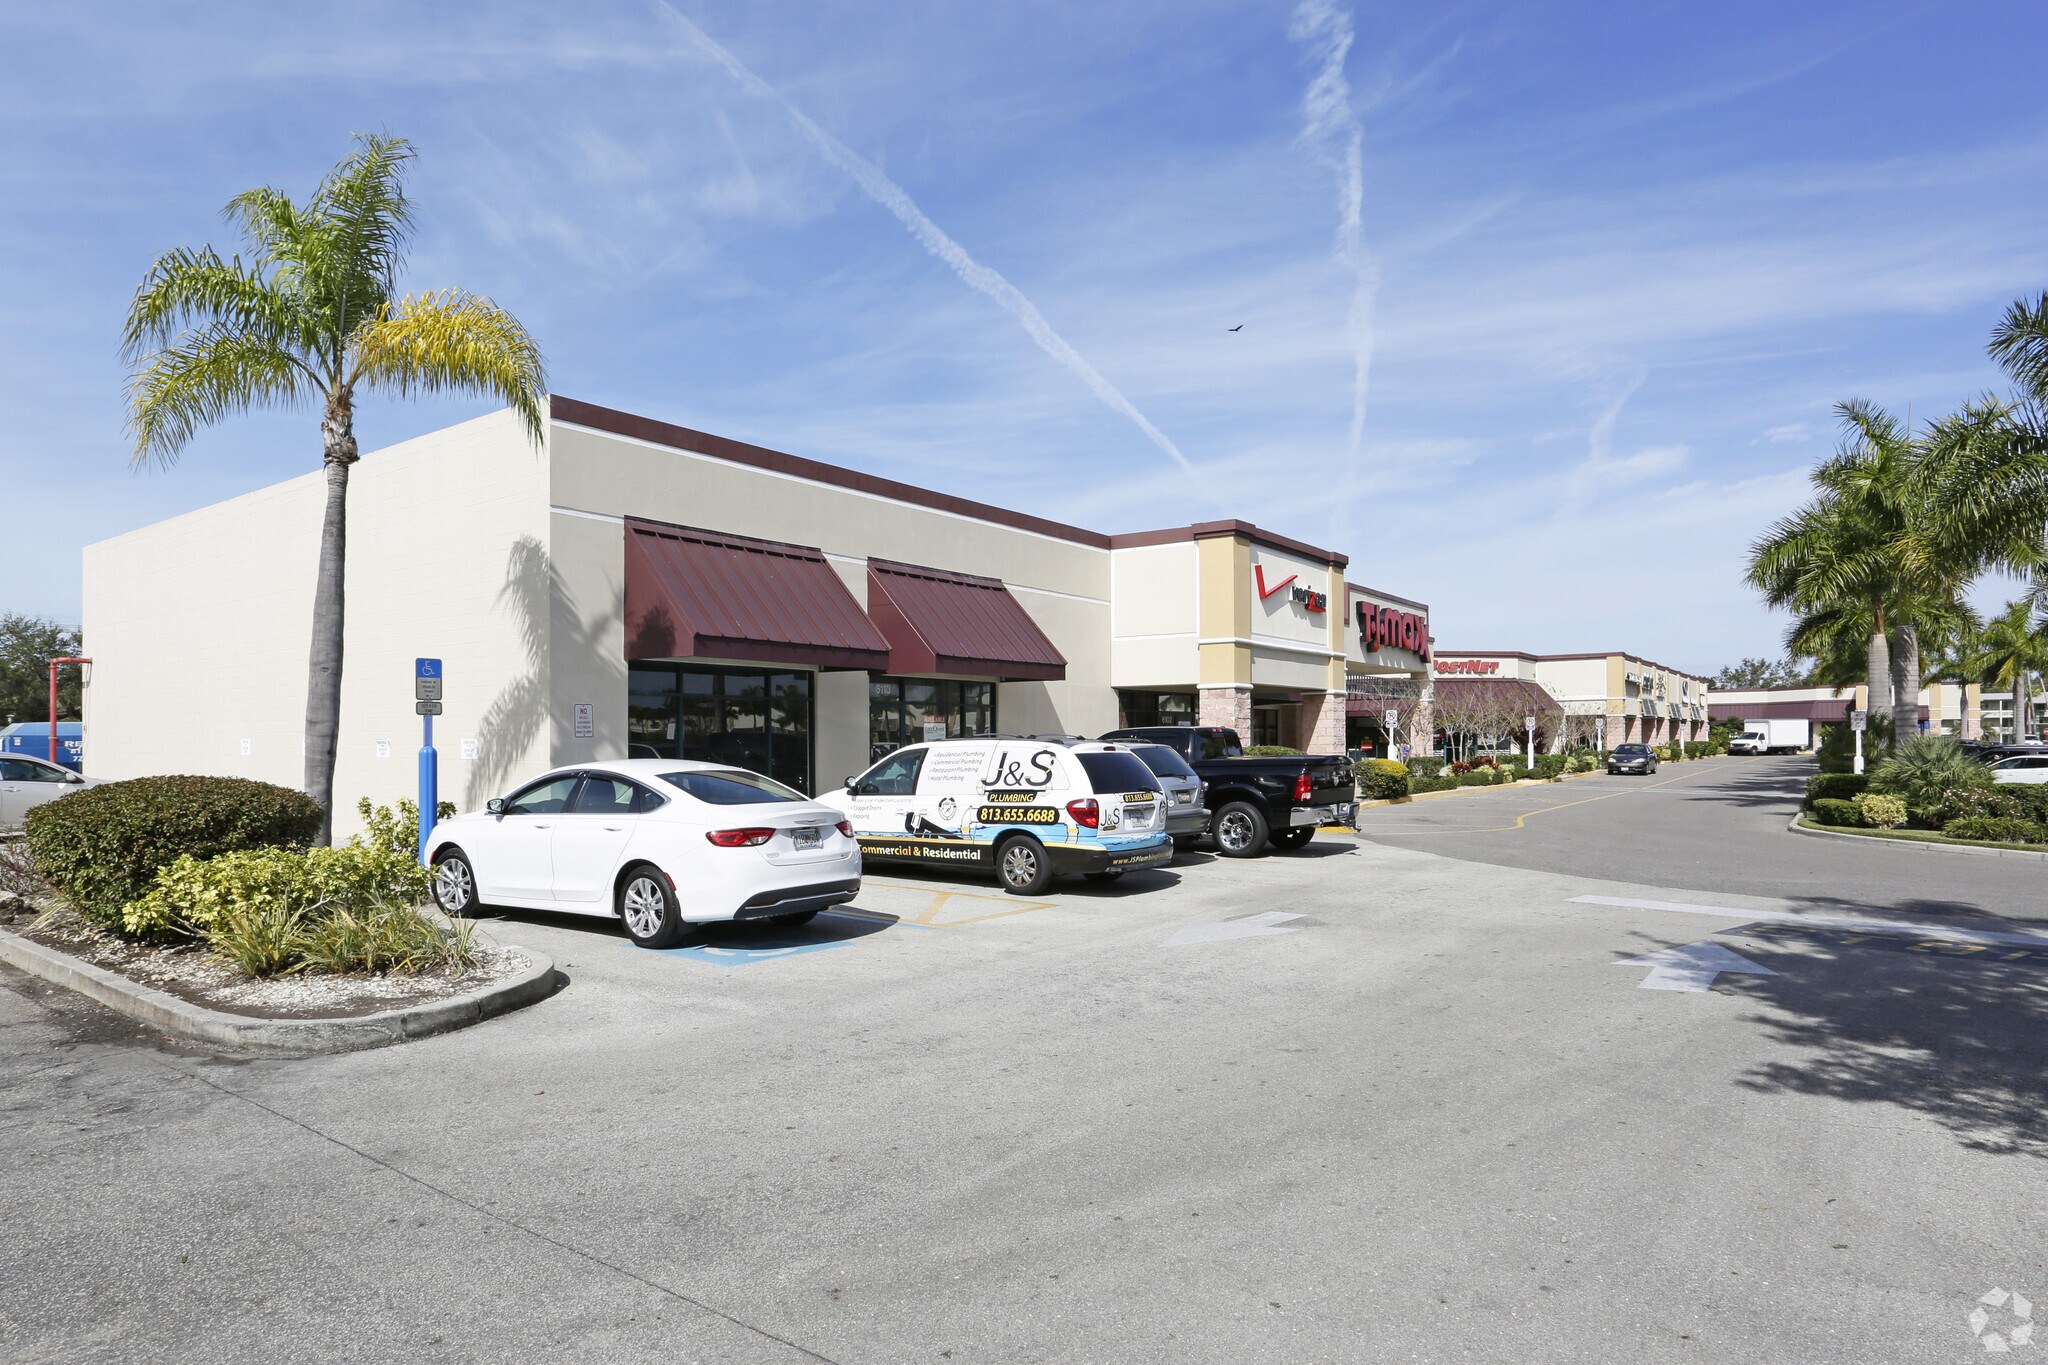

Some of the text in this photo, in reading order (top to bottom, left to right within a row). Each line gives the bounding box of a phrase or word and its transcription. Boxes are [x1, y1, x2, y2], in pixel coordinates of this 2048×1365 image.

[1292, 585, 1326, 612] verizon
[980, 750, 1055, 787] J&S
[989, 793, 1034, 803] PLUMBING
[980, 808, 1056, 823] 813.655.6688
[1100, 808, 1120, 826] J&S
[913, 847, 921, 856] &
[923, 847, 981, 860] Residential
